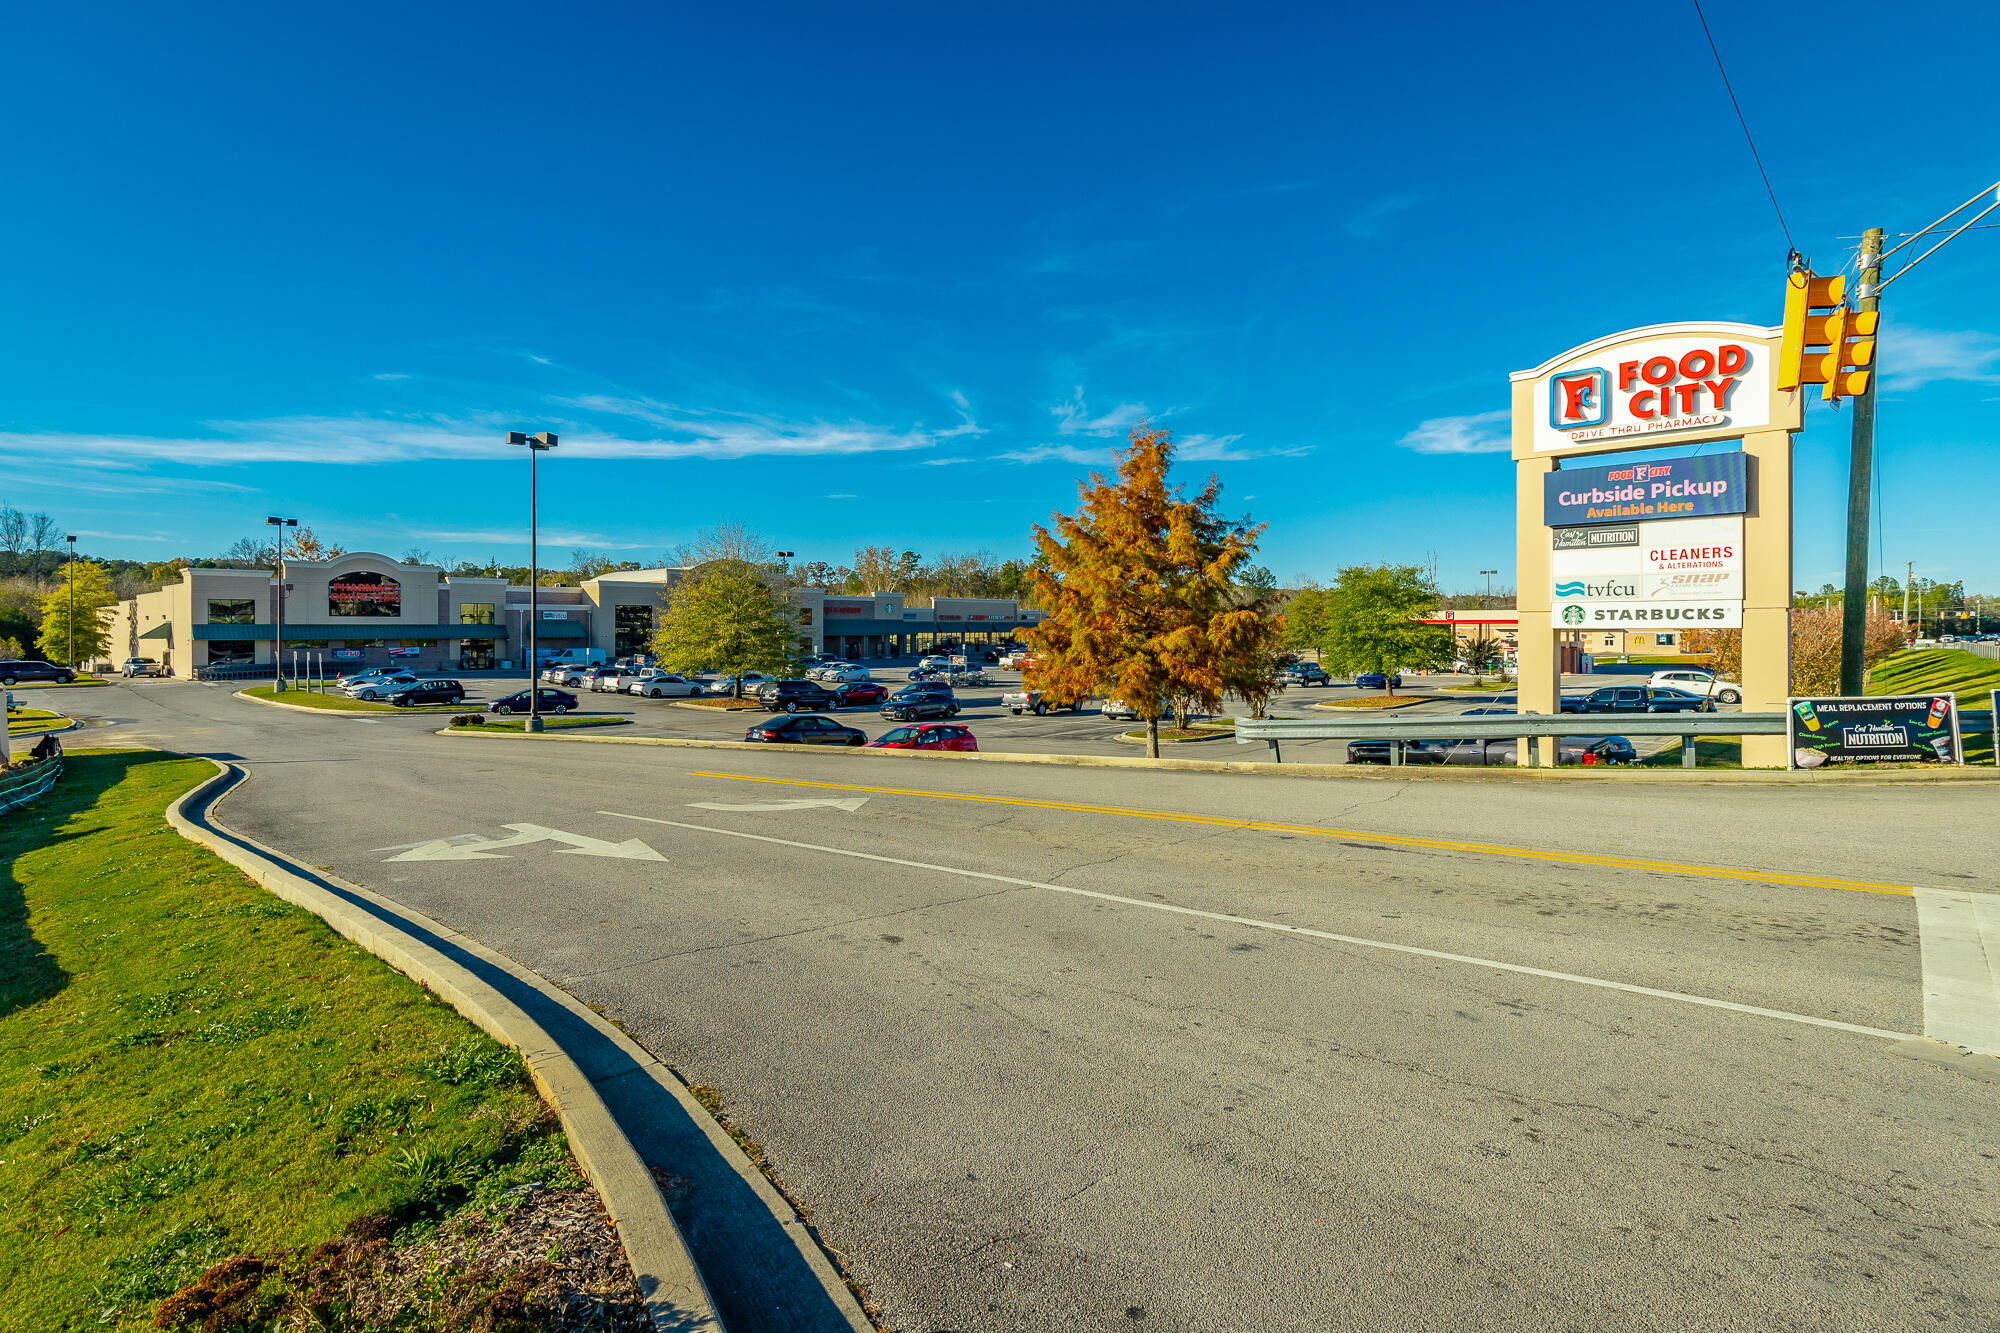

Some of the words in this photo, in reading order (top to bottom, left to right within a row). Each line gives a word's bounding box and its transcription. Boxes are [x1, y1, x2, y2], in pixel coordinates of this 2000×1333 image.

[1618, 344, 1747, 391] FOOD
[1628, 376, 1736, 420] CITY
[1571, 428, 1605, 440] DRIVE
[1609, 424, 1641, 435] THRU
[1647, 414, 1719, 431] PHARMACY
[1607, 470, 1634, 482] FOOD
[1648, 465, 1673, 477] CITY
[1558, 484, 1645, 507] Curbside
[1650, 479, 1728, 499] Pickup
[1586, 502, 1653, 519] Available
[1657, 501, 1695, 514] Here
[1590, 530, 1635, 544] NUTRITION
[1649, 546, 1733, 562] CLEANERS
[1666, 560, 1724, 570] ALTERATIONS
[333, 583, 398, 593] PHARMACY
[1586, 579, 1636, 597] tvfcu
[1594, 608, 1725, 621] STARBUCKS
[1816, 704, 1838, 713] MEAL
[1838, 703, 1892, 712] REPLACEMENT
[1894, 701, 1927, 710] OPTIONS
[1847, 732, 1904, 746] NUTRITION
